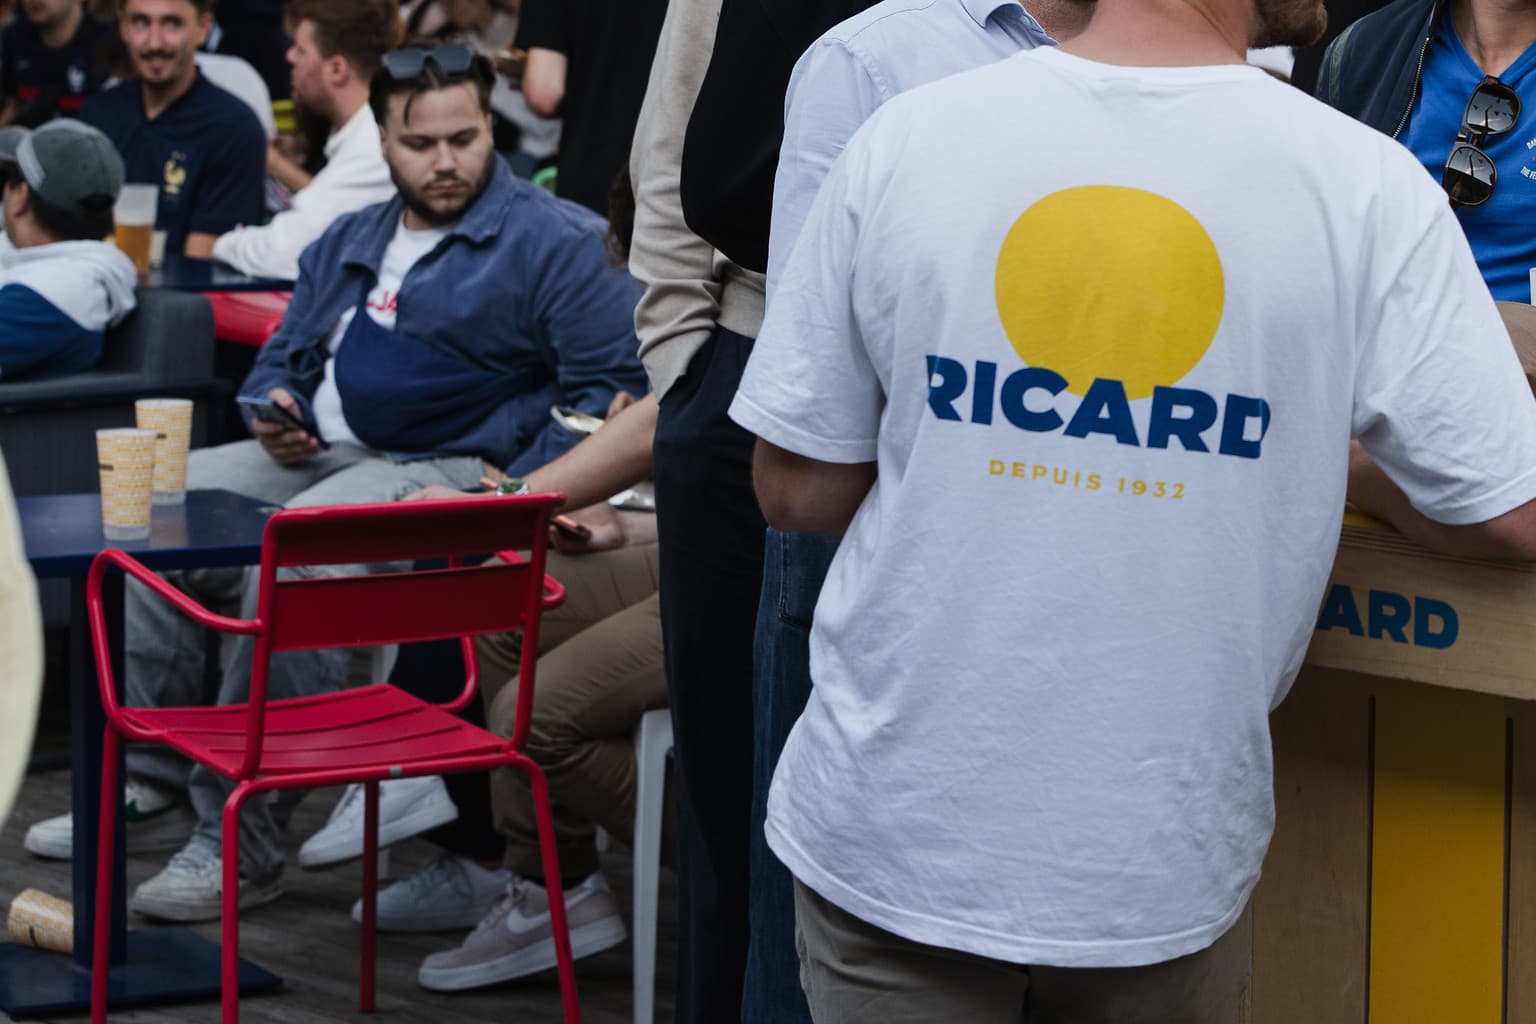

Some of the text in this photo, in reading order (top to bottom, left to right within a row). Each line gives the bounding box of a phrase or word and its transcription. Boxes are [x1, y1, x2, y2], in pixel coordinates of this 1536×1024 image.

[926, 354, 1271, 459] RICARD
[989, 459, 1186, 500] DEPUIS 1932
